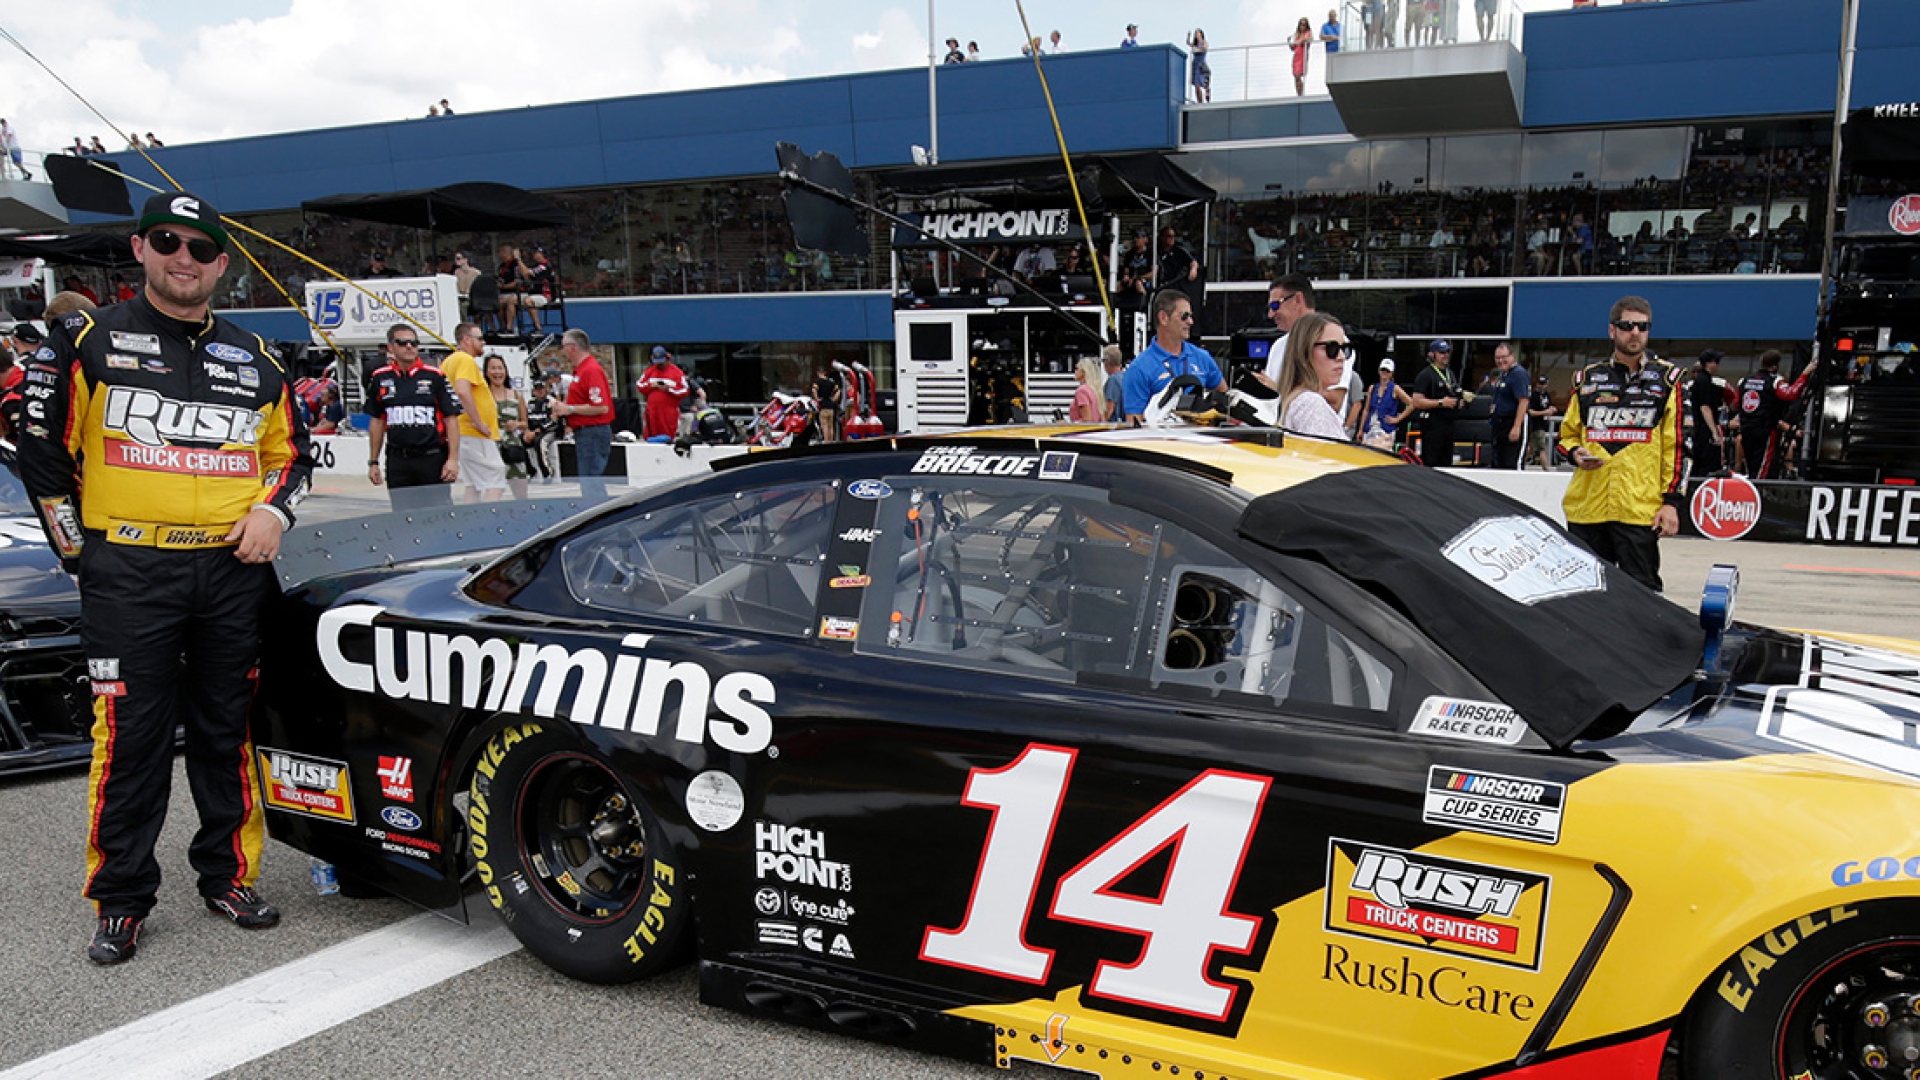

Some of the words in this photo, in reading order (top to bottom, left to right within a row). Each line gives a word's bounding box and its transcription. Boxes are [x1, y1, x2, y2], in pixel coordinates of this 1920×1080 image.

[922, 209, 1061, 239] HIGHPOINT
[313, 288, 345, 328] 15
[368, 289, 435, 310] JACOB
[103, 386, 264, 447] RUSH
[120, 445, 181, 468] TRUCK
[186, 452, 250, 473] CENTERS
[311, 441, 335, 468] 26
[911, 455, 1040, 476] BRISCOE
[1699, 478, 1755, 530] Rheem
[1806, 487, 1920, 544] RHEE
[316, 604, 776, 754] Cummins
[1428, 719, 1469, 734] RACE
[1473, 724, 1509, 738] CAR
[1453, 703, 1518, 725] NASCAR
[270, 753, 339, 790] RUSH
[1469, 775, 1545, 802] NASCAR
[1442, 798, 1478, 816] CUP
[1478, 803, 1541, 827] SERIES
[755, 822, 825, 858] HIGH
[755, 851, 843, 890] POINT
[918, 742, 1274, 1022] 14
[1350, 849, 1524, 918] RUSH
[623, 858, 676, 963] EAGLE
[1364, 904, 1419, 930] TRUCK
[1422, 915, 1500, 945] CENTERS
[1321, 942, 1534, 1021] RushCare
